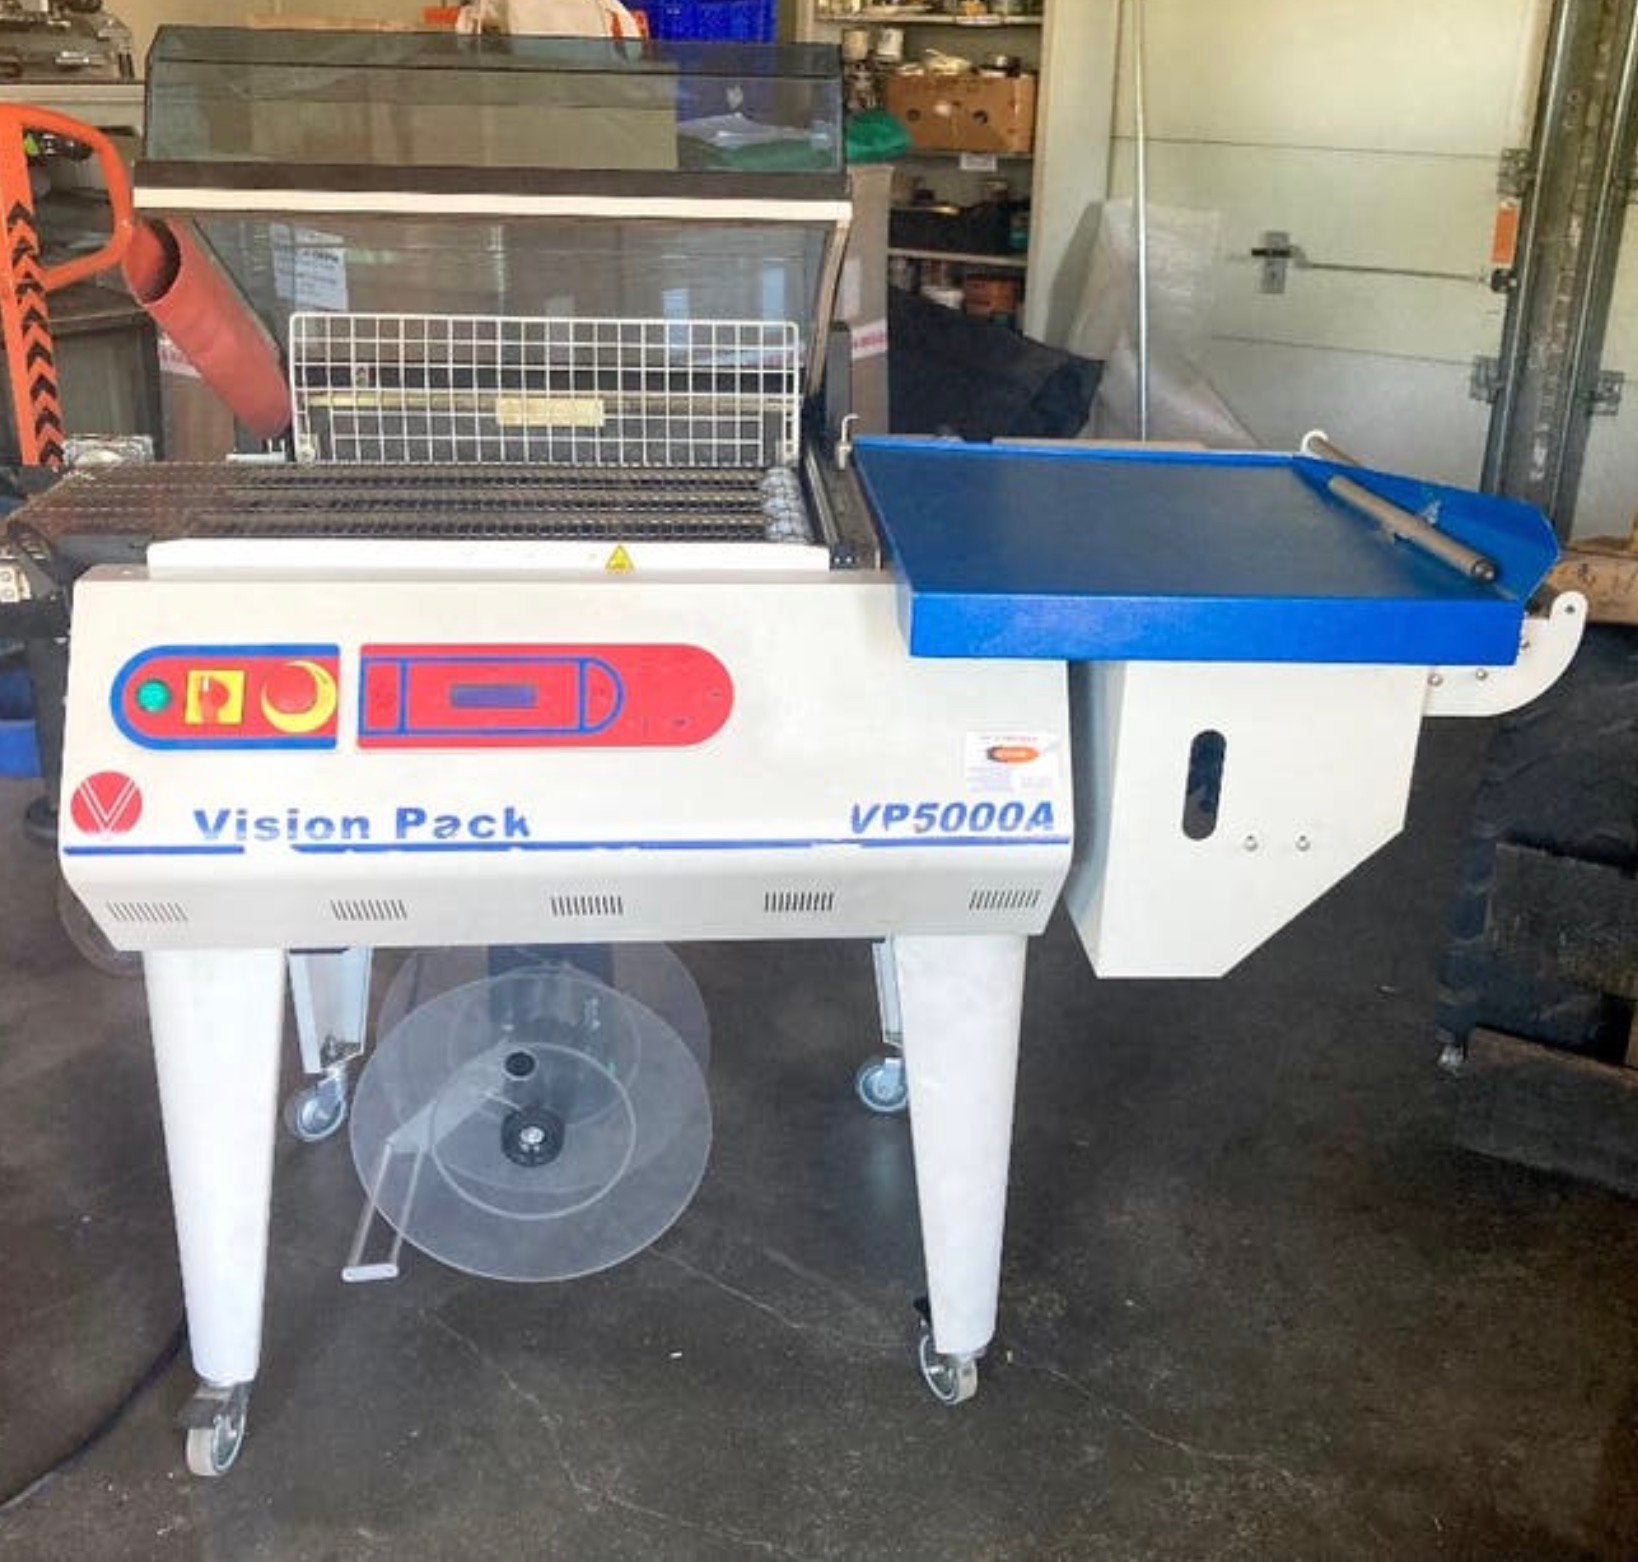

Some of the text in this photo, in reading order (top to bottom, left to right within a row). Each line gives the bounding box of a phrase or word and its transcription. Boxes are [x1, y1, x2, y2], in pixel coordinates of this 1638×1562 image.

[193, 806, 531, 840] Vision Pack
[850, 800, 1054, 834] VP5000A
